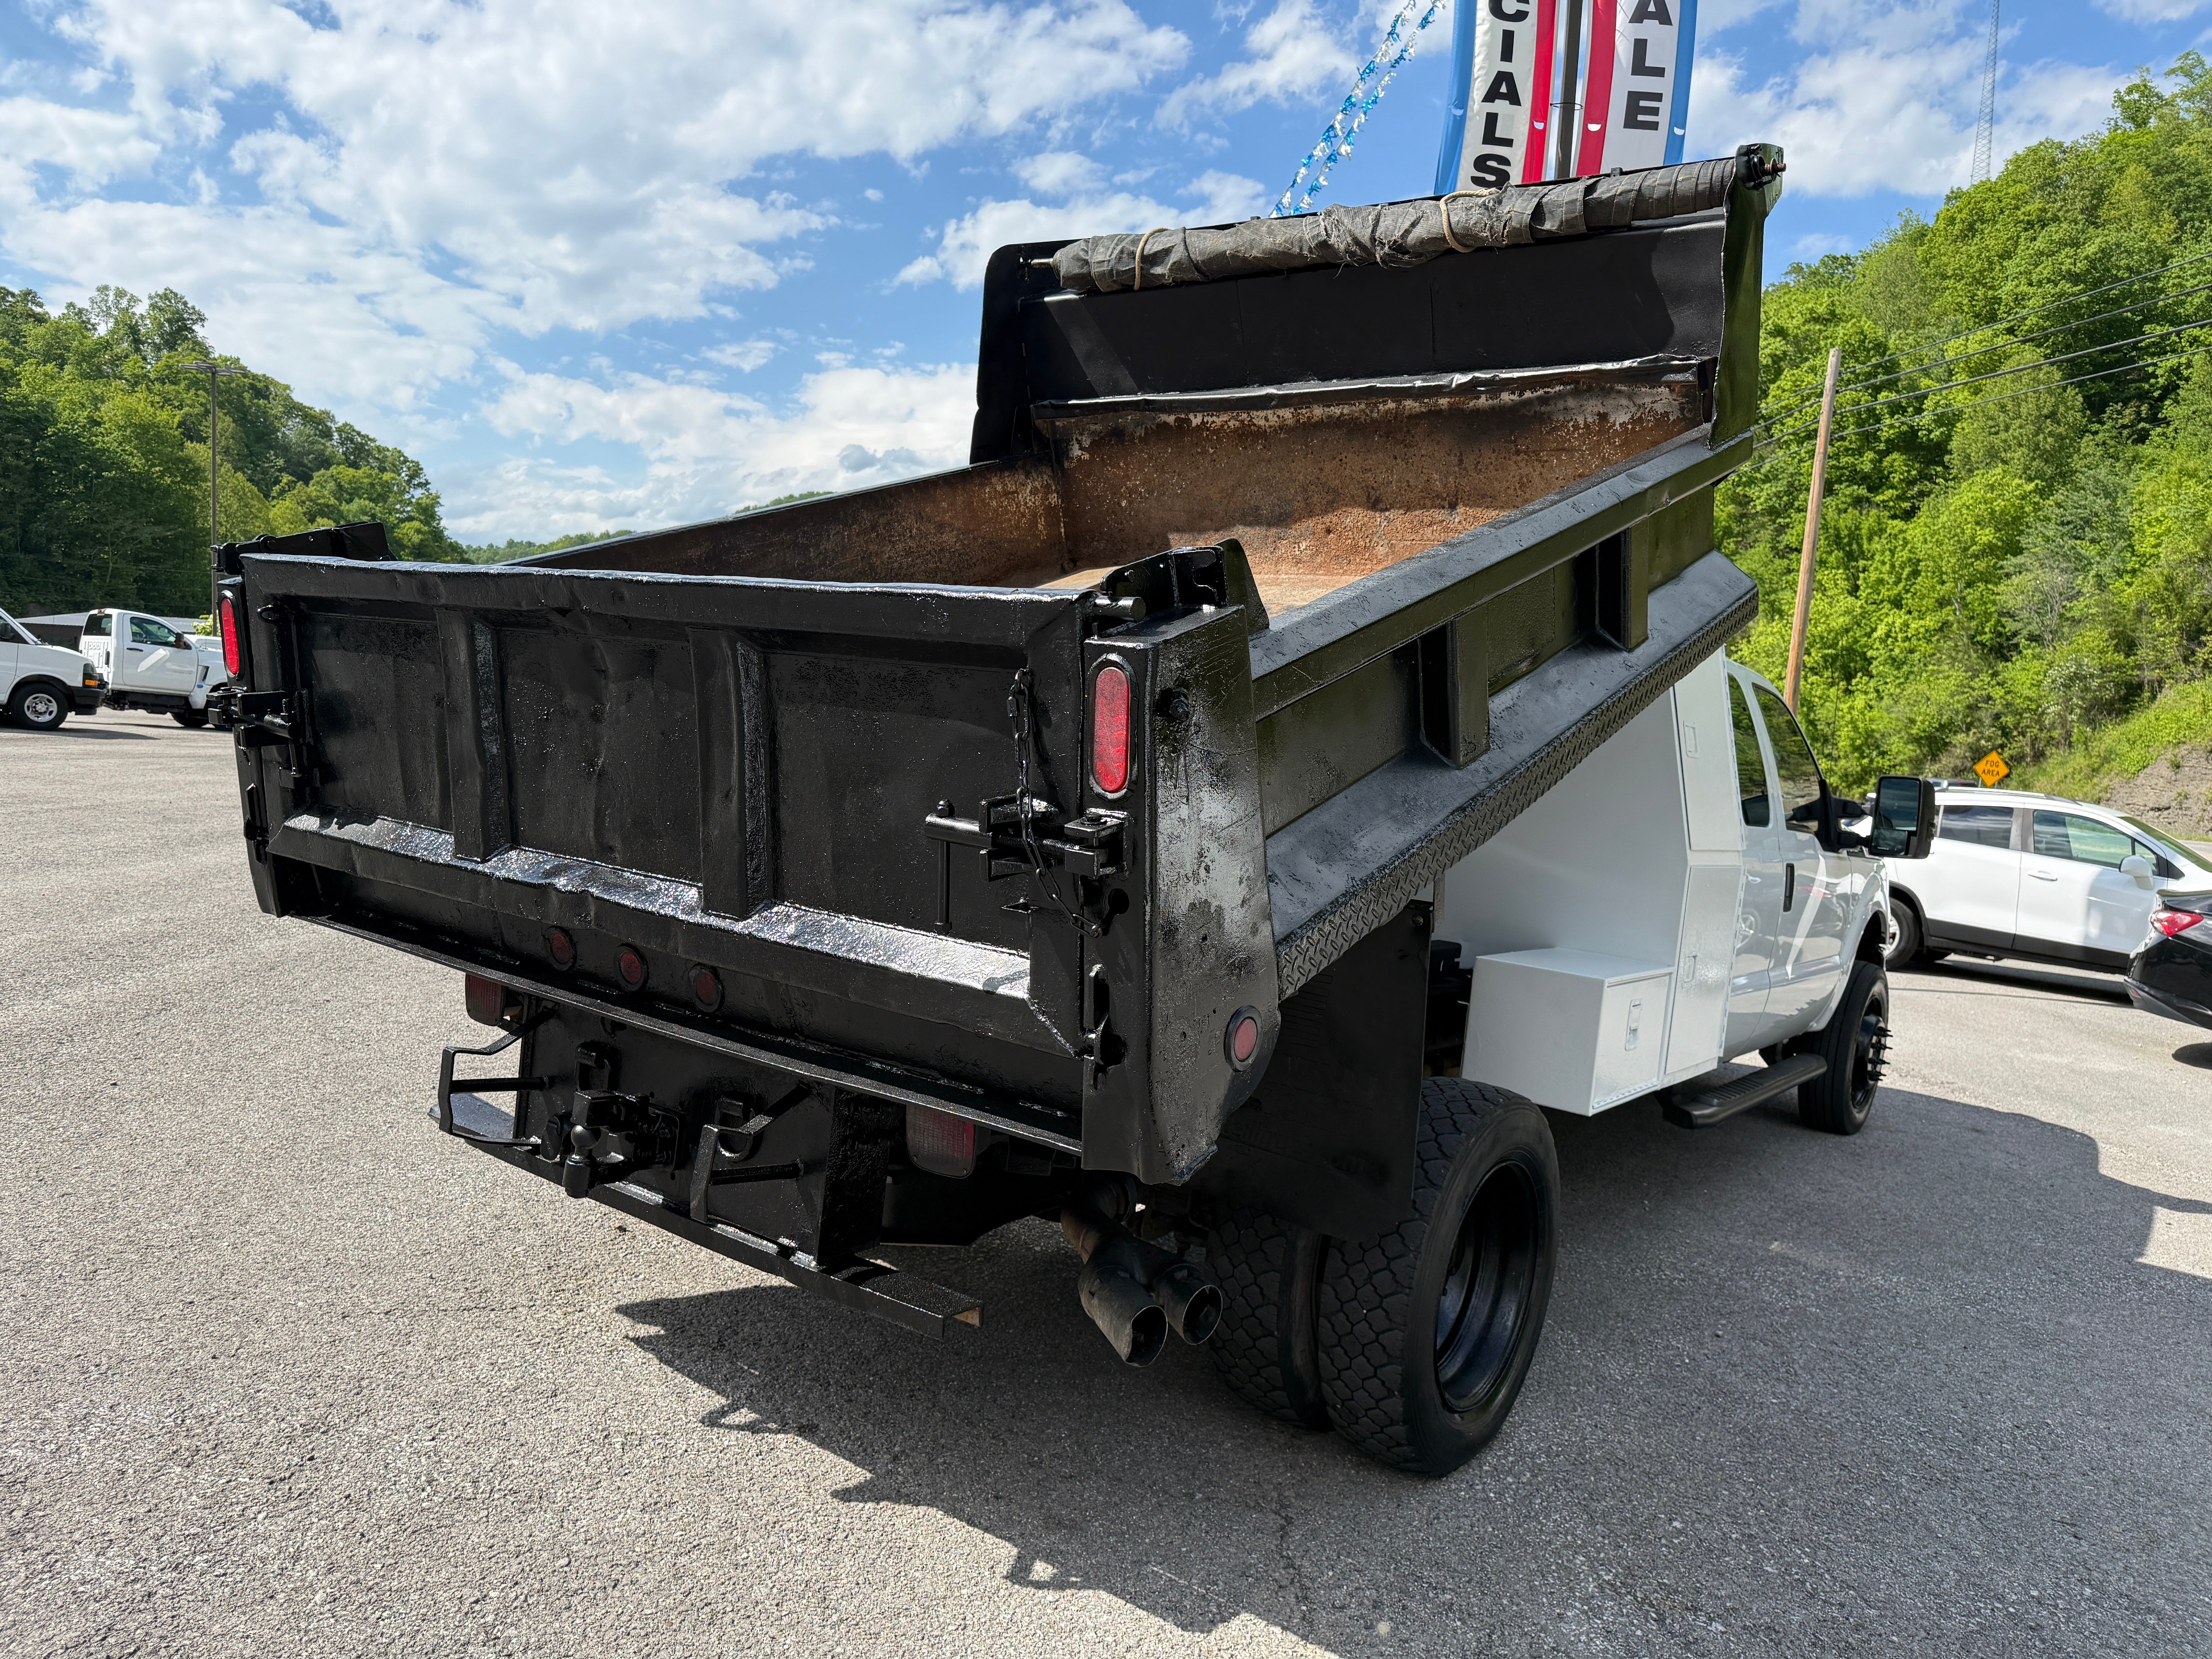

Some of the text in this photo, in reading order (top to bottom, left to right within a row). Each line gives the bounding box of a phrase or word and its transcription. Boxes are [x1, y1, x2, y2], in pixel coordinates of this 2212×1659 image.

[1623, 0, 1673, 131] ALE
[1985, 759, 1999, 768] FOG
[1981, 768, 2000, 777] AREA
